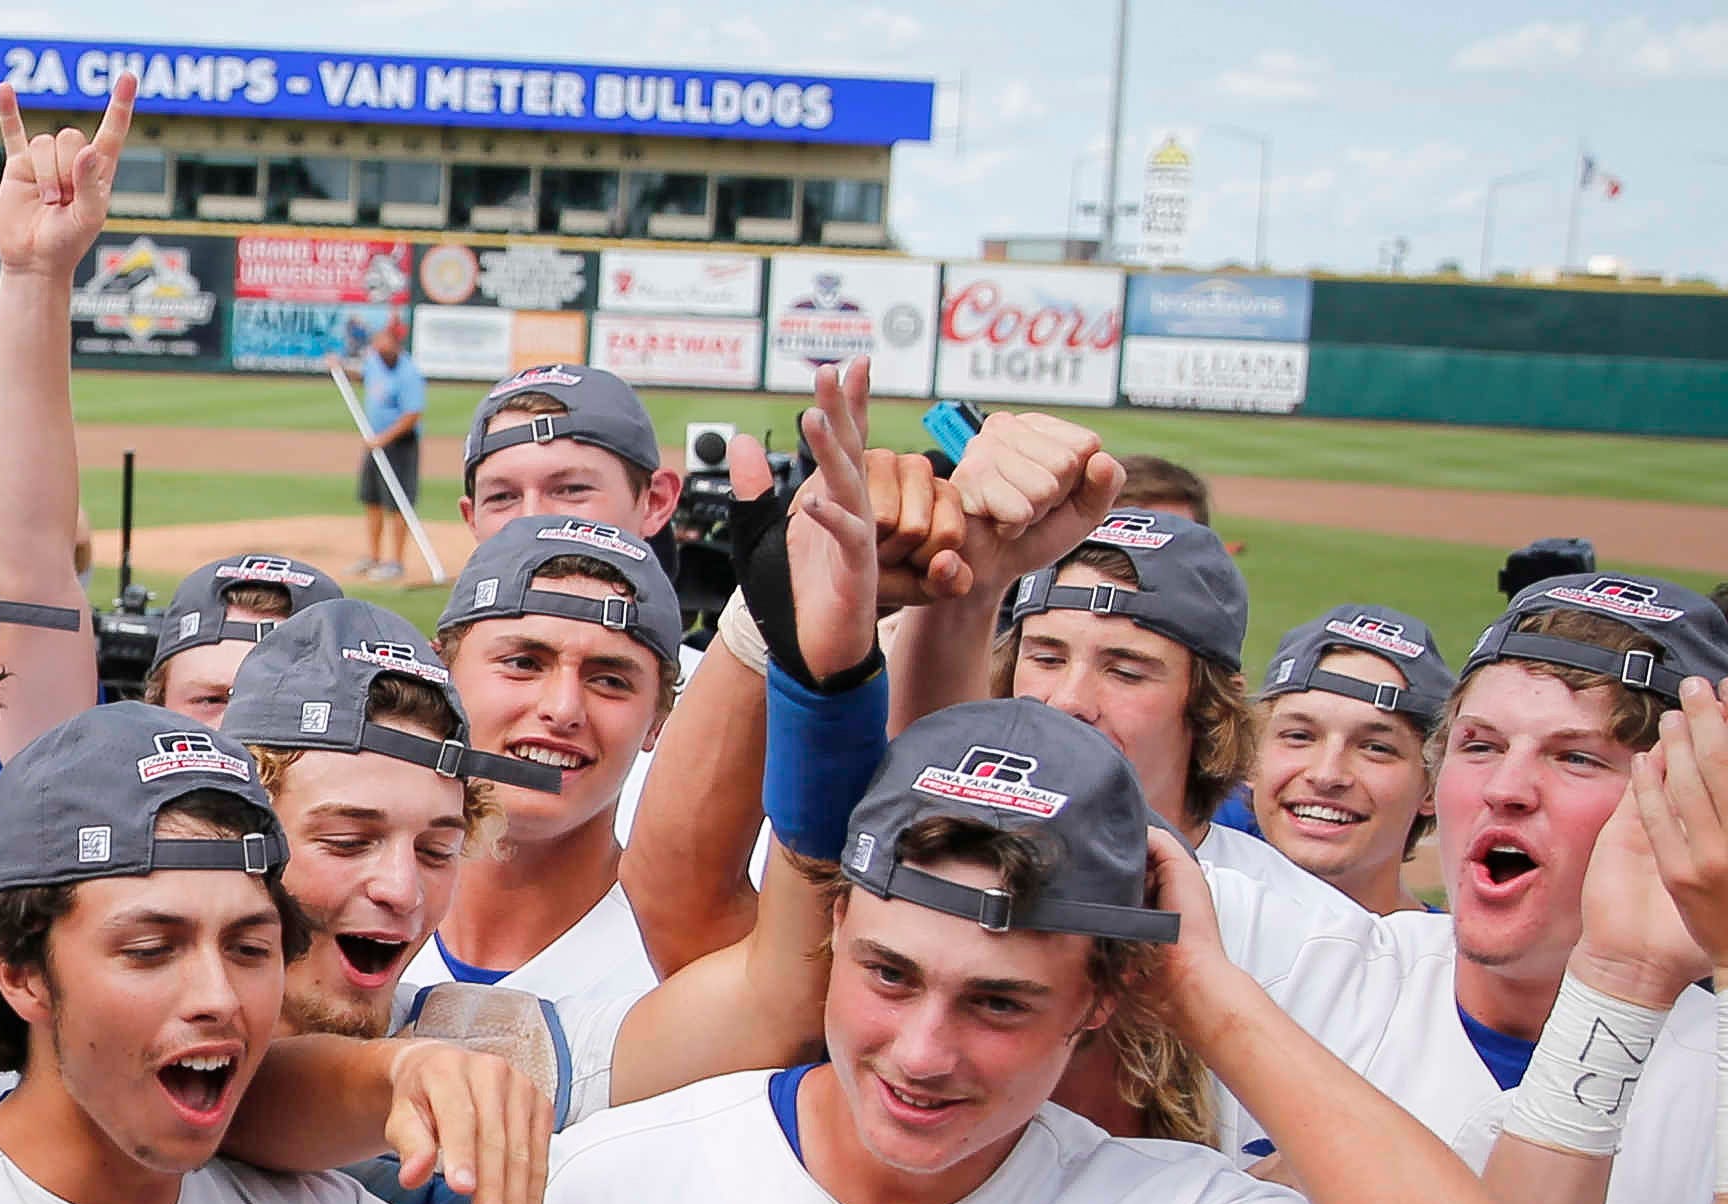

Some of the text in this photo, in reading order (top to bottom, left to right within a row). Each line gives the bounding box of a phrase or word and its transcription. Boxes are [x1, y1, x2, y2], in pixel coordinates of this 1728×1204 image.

[4, 47, 69, 95] 2A
[76, 50, 278, 104] CHAMPS
[318, 60, 418, 111] VAN
[425, 66, 586, 118] METER
[593, 73, 833, 129] BULLDOGS
[941, 281, 1121, 349] Coors
[971, 351, 1083, 384] LIGHT
[927, 769, 1059, 804] IOWA FARM BUREAU
